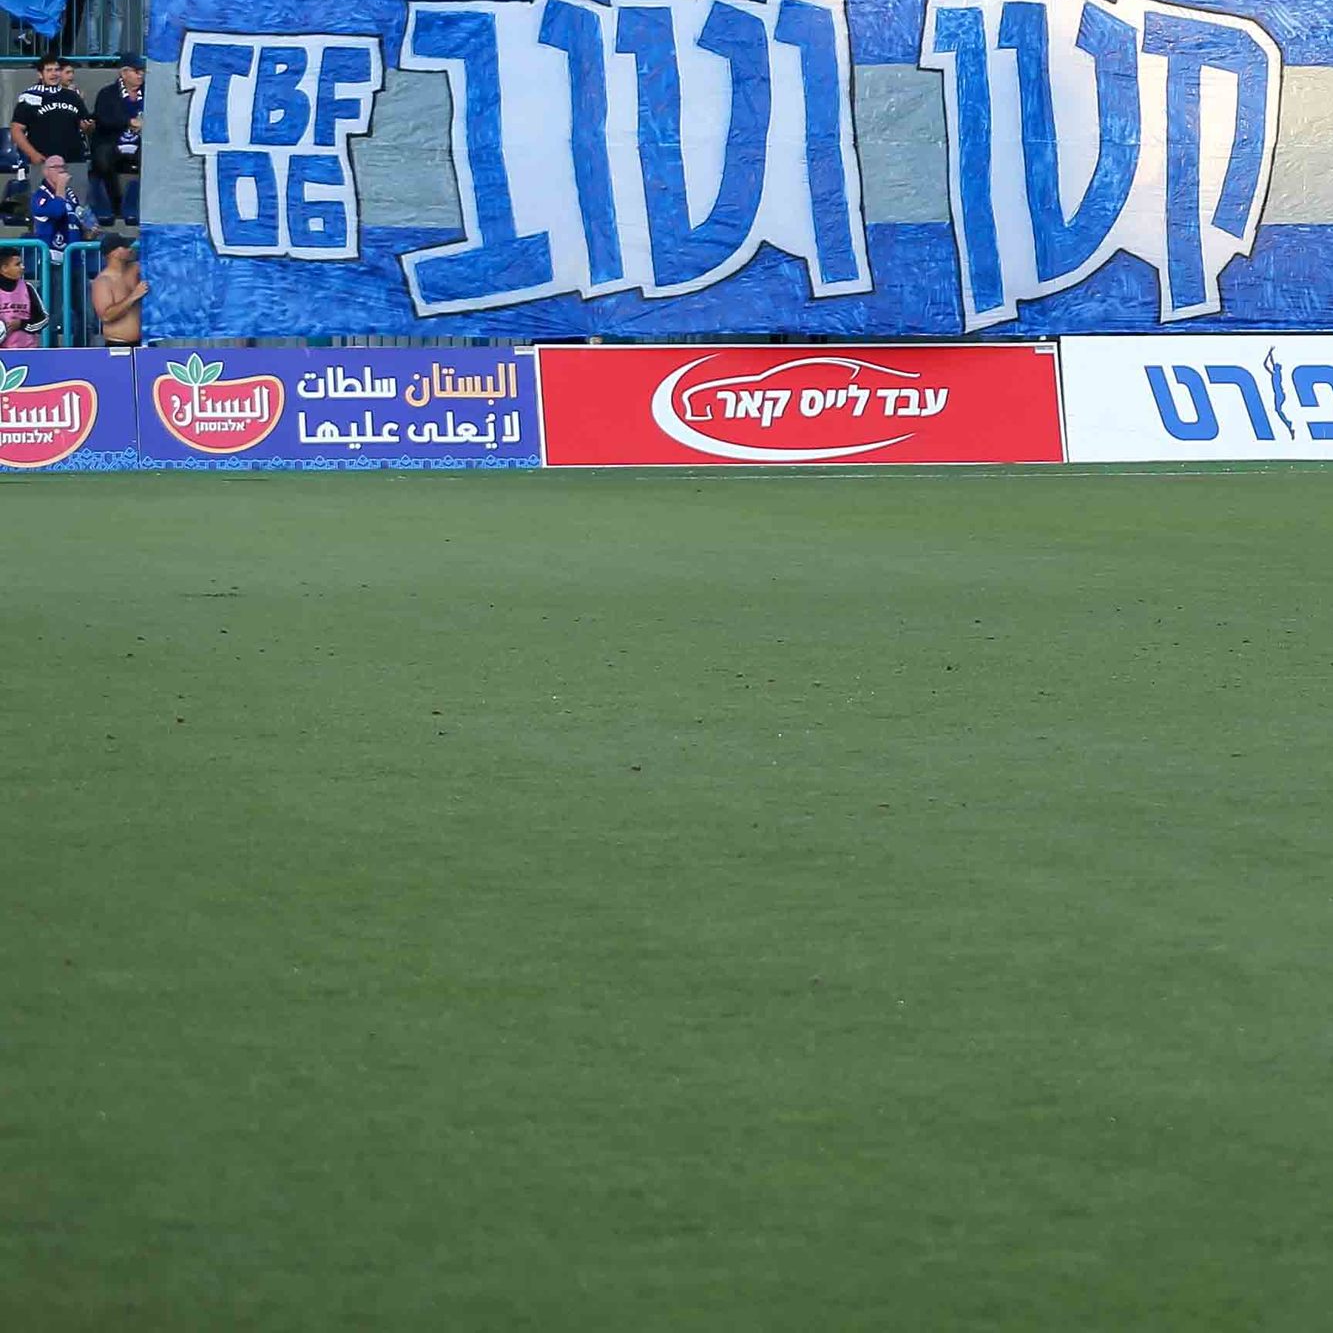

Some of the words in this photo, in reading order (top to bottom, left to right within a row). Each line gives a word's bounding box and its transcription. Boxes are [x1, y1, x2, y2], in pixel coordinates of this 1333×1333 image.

[185, 36, 377, 150] TBF
[212, 148, 353, 254] 06
[297, 366, 397, 398] سلطات
[405, 363, 517, 407] البستان
[800, 384, 869, 417] לייס
[717, 389, 791, 427] קאר
[876, 388, 948, 416] עבד
[195, 420, 245, 434] אלבוסתן
[299, 411, 400, 449] عليها
